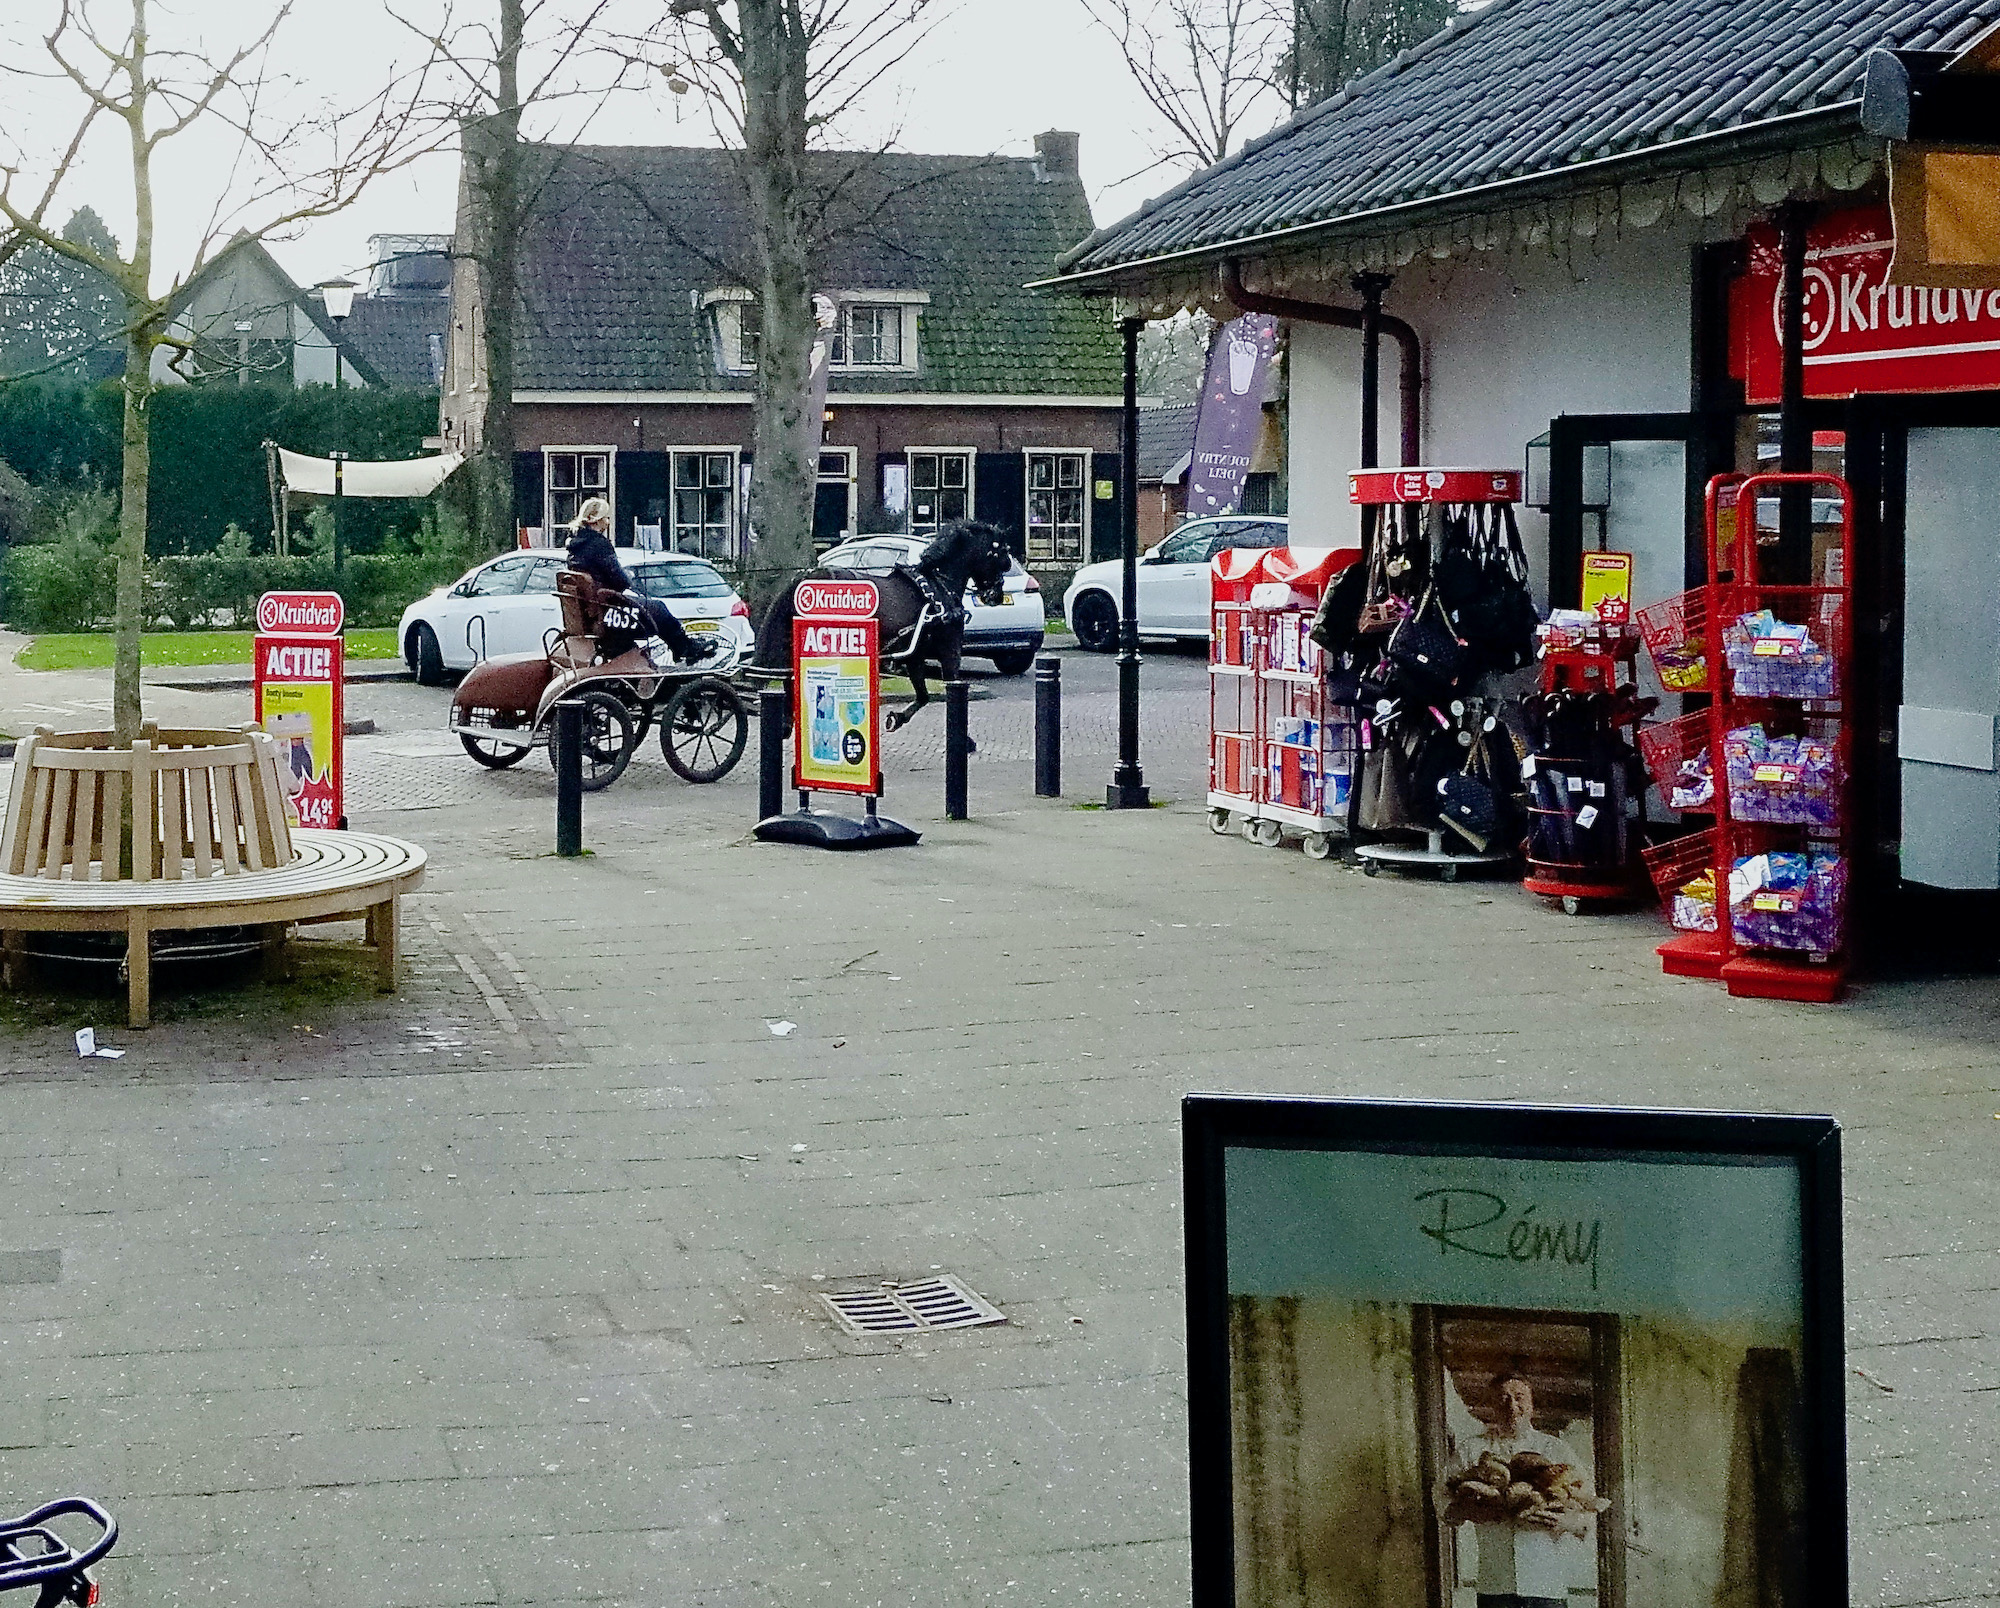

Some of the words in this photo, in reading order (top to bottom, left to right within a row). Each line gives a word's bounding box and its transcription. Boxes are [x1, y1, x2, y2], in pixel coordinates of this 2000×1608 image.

[278, 602, 336, 625] Kruidvat
[815, 589, 872, 610] Kruidvat
[803, 626, 867, 655] ACTIE!
[266, 646, 331, 679] ACTIE!
[1414, 1188, 1600, 1291] Rémy
